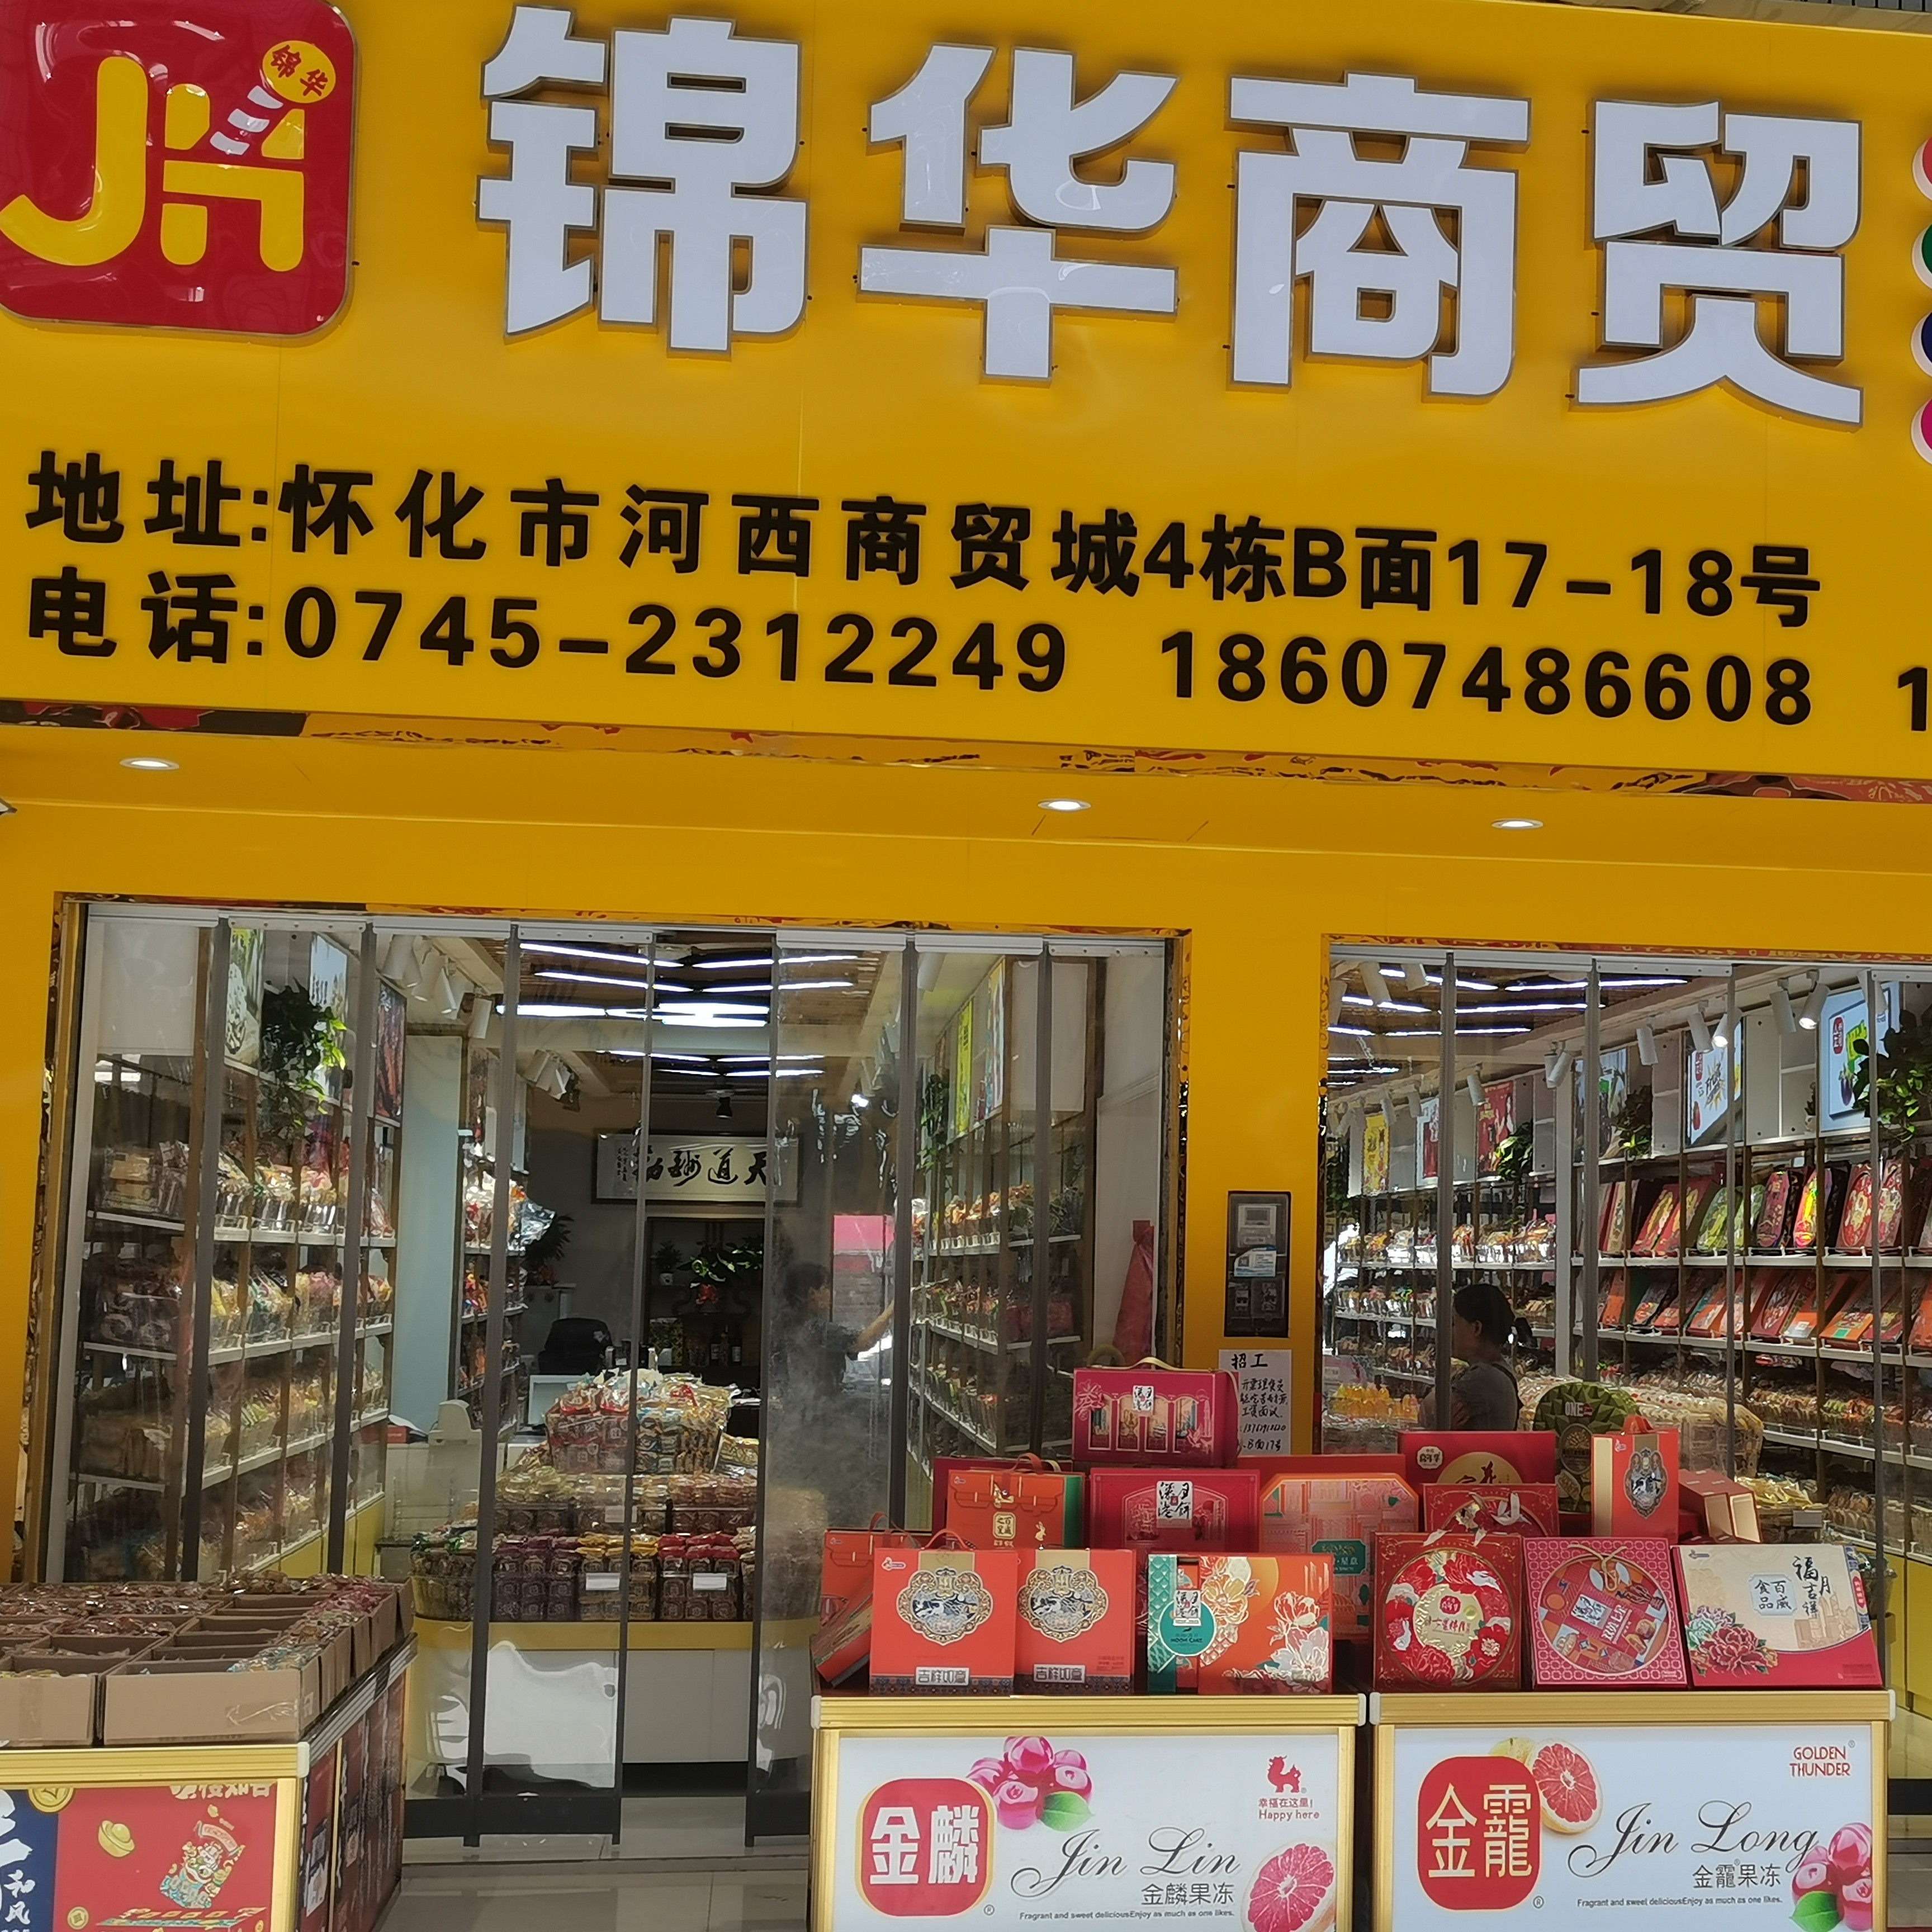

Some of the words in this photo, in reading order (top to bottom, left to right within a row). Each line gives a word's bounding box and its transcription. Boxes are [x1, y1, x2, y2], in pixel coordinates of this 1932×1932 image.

[271, 43, 330, 98] 锦华
[478, 6, 1863, 428] 锦华商贸
[28, 566, 1066, 693] 电话:0745-2312249
[1161, 631, 1812, 726] 18607486608
[1897, 666, 1929, 732] 1
[1231, 1353, 1268, 1370] 招工
[918, 1669, 967, 1683] 吉祥如意
[1036, 1666, 1082, 1681] 吉祥如意
[1793, 1746, 1846, 1760] GOLDEN
[1789, 1763, 1850, 1777] THUNDER
[1259, 1809, 1292, 1821] Happy
[1296, 1809, 1320, 1819] here
[870, 1805, 979, 1884] 金麟
[1568, 1802, 1679, 1878] Jin
[1690, 1800, 1820, 1873] Long
[1011, 1829, 1128, 1898] Jin
[1140, 1826, 1241, 1875] Lin
[3, 1869, 36, 1932] 和风
[1141, 1882, 1234, 1905] 金麟果冻
[1577, 1898, 1609, 1908] Fragrant
[1715, 1896, 1736, 1905] much
